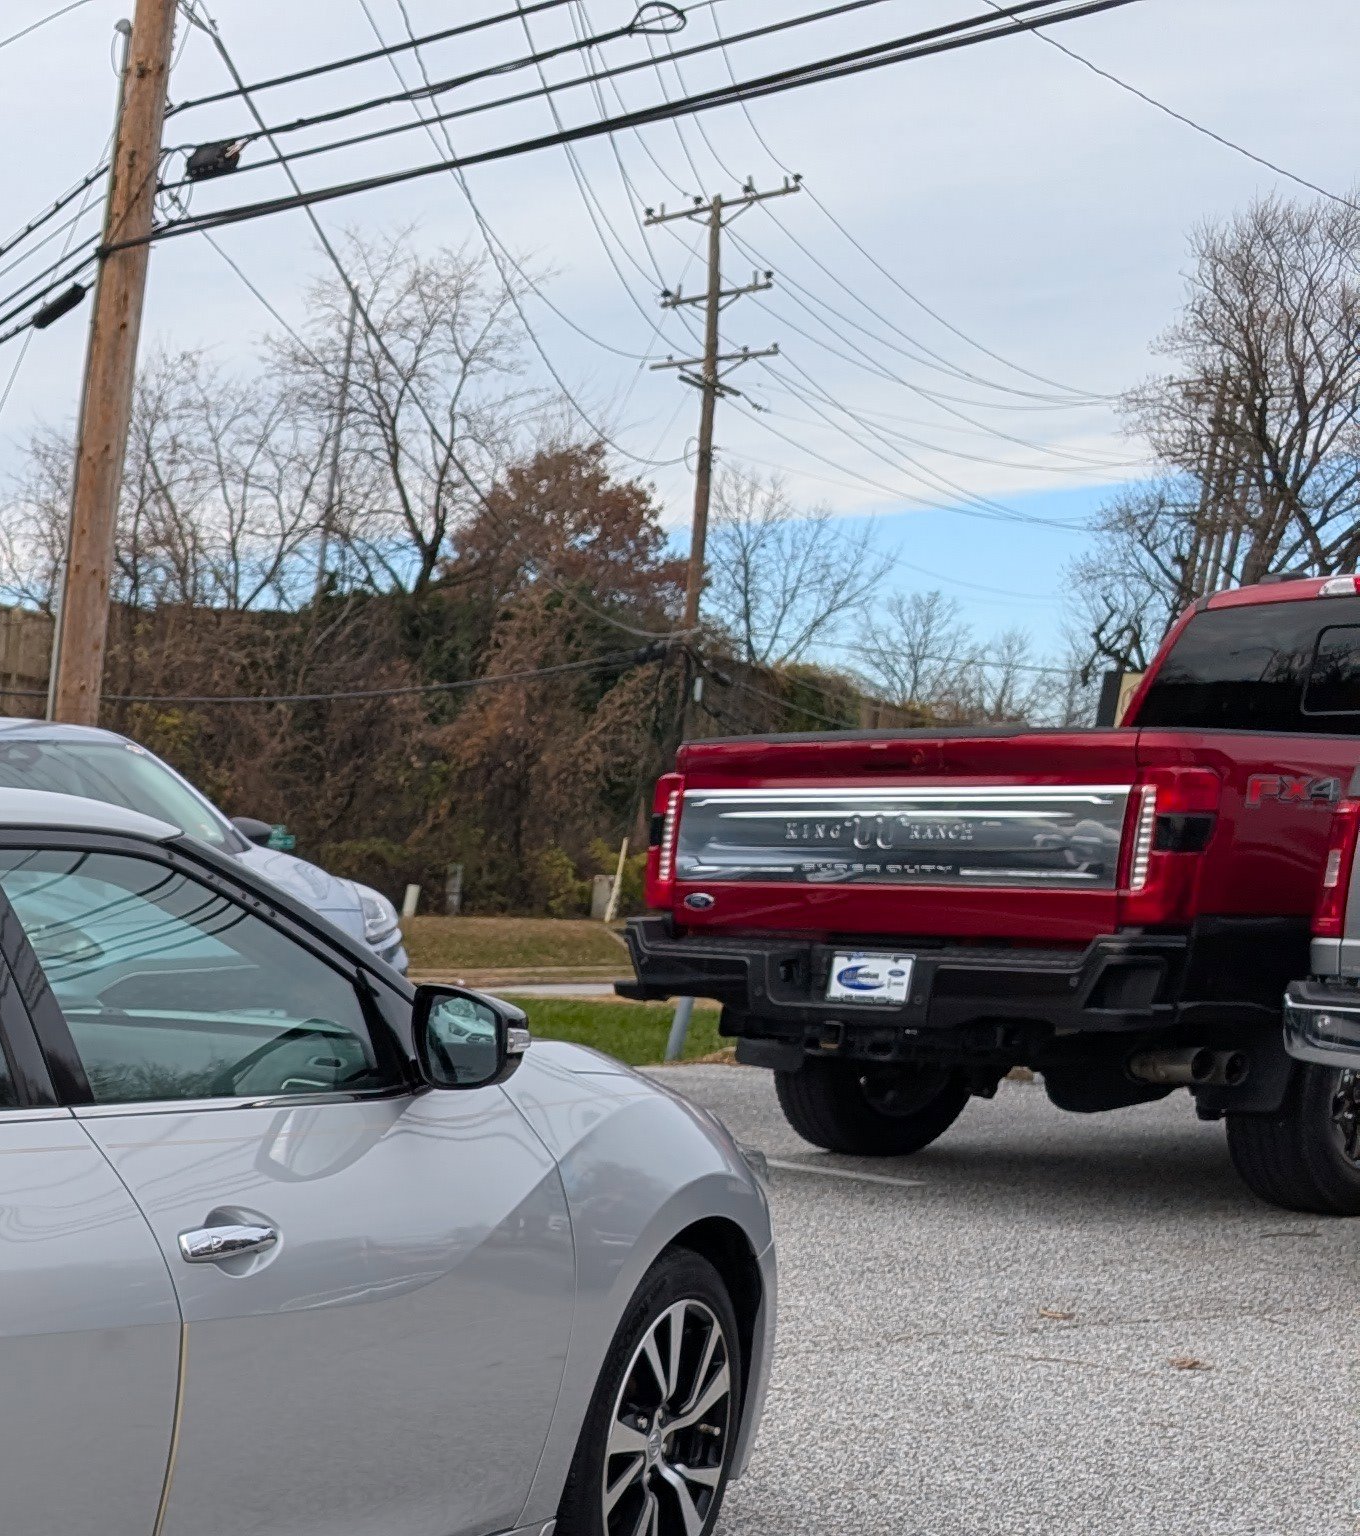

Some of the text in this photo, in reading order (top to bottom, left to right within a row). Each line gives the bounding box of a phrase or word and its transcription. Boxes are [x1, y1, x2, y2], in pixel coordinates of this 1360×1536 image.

[1245, 774, 1340, 809] FX4
[785, 822, 973, 841] KING RANCH
